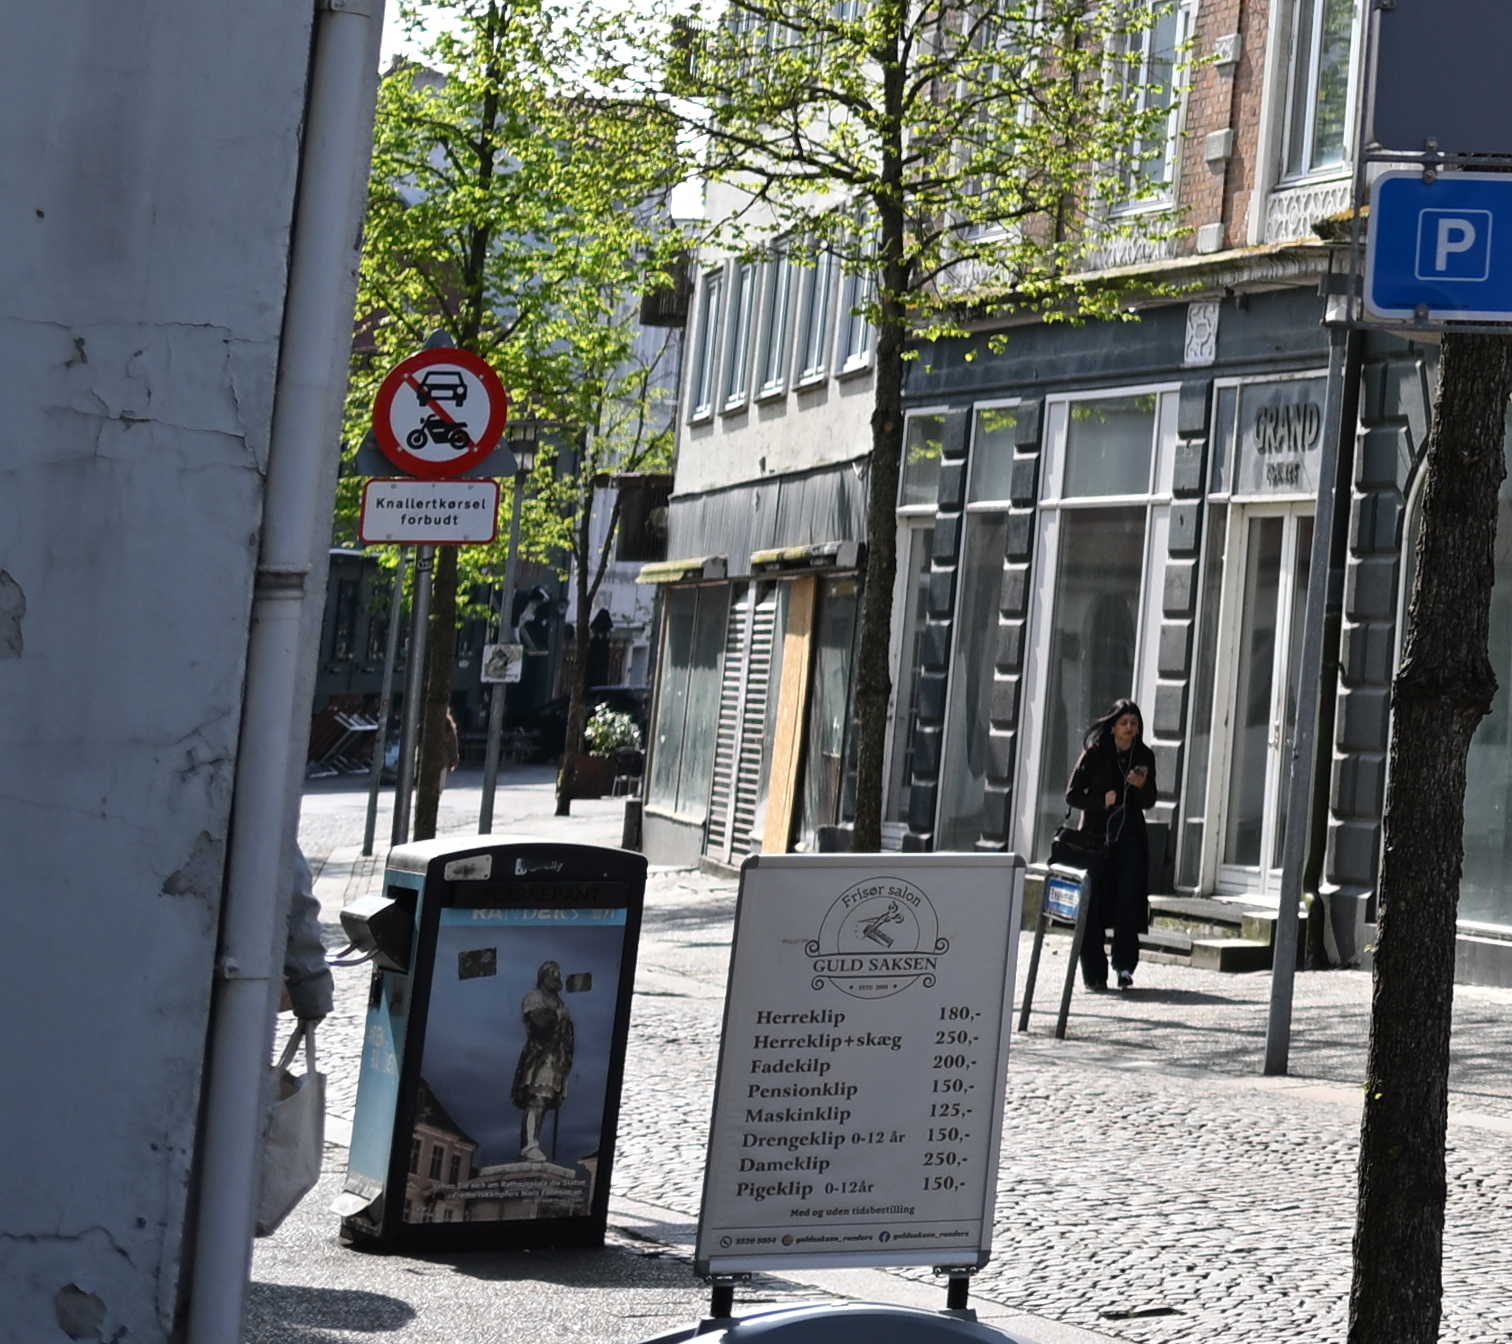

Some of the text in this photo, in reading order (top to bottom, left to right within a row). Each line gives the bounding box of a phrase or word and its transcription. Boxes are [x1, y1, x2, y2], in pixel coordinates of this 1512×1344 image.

[1435, 218, 1476, 272] P
[1256, 402, 1320, 455] GRAND
[375, 497, 486, 510] Knallertkørsel
[400, 513, 458, 526] forbudt
[841, 883, 922, 909] Frisør salon
[812, 956, 937, 973] GULD SAKSEN
[756, 1006, 981, 1028] Herreklip 180,-
[753, 1030, 979, 1053] Herreklip+skæg 250,-
[932, 1054, 977, 1071] 200,-
[747, 1078, 975, 1101] Pensionklip 150,-
[745, 1102, 973, 1125] Maskinklip 125,-
[741, 1127, 971, 1152] Drengeklip 0-12 år 150,-
[739, 1151, 968, 1175] Dameklip 250,-
[736, 1181, 814, 1202] Pigeklip
[923, 1175, 966, 1192] 150,-
[790, 1207, 811, 1218] Med
[812, 1209, 824, 1220] og
[825, 1206, 850, 1217] uden
